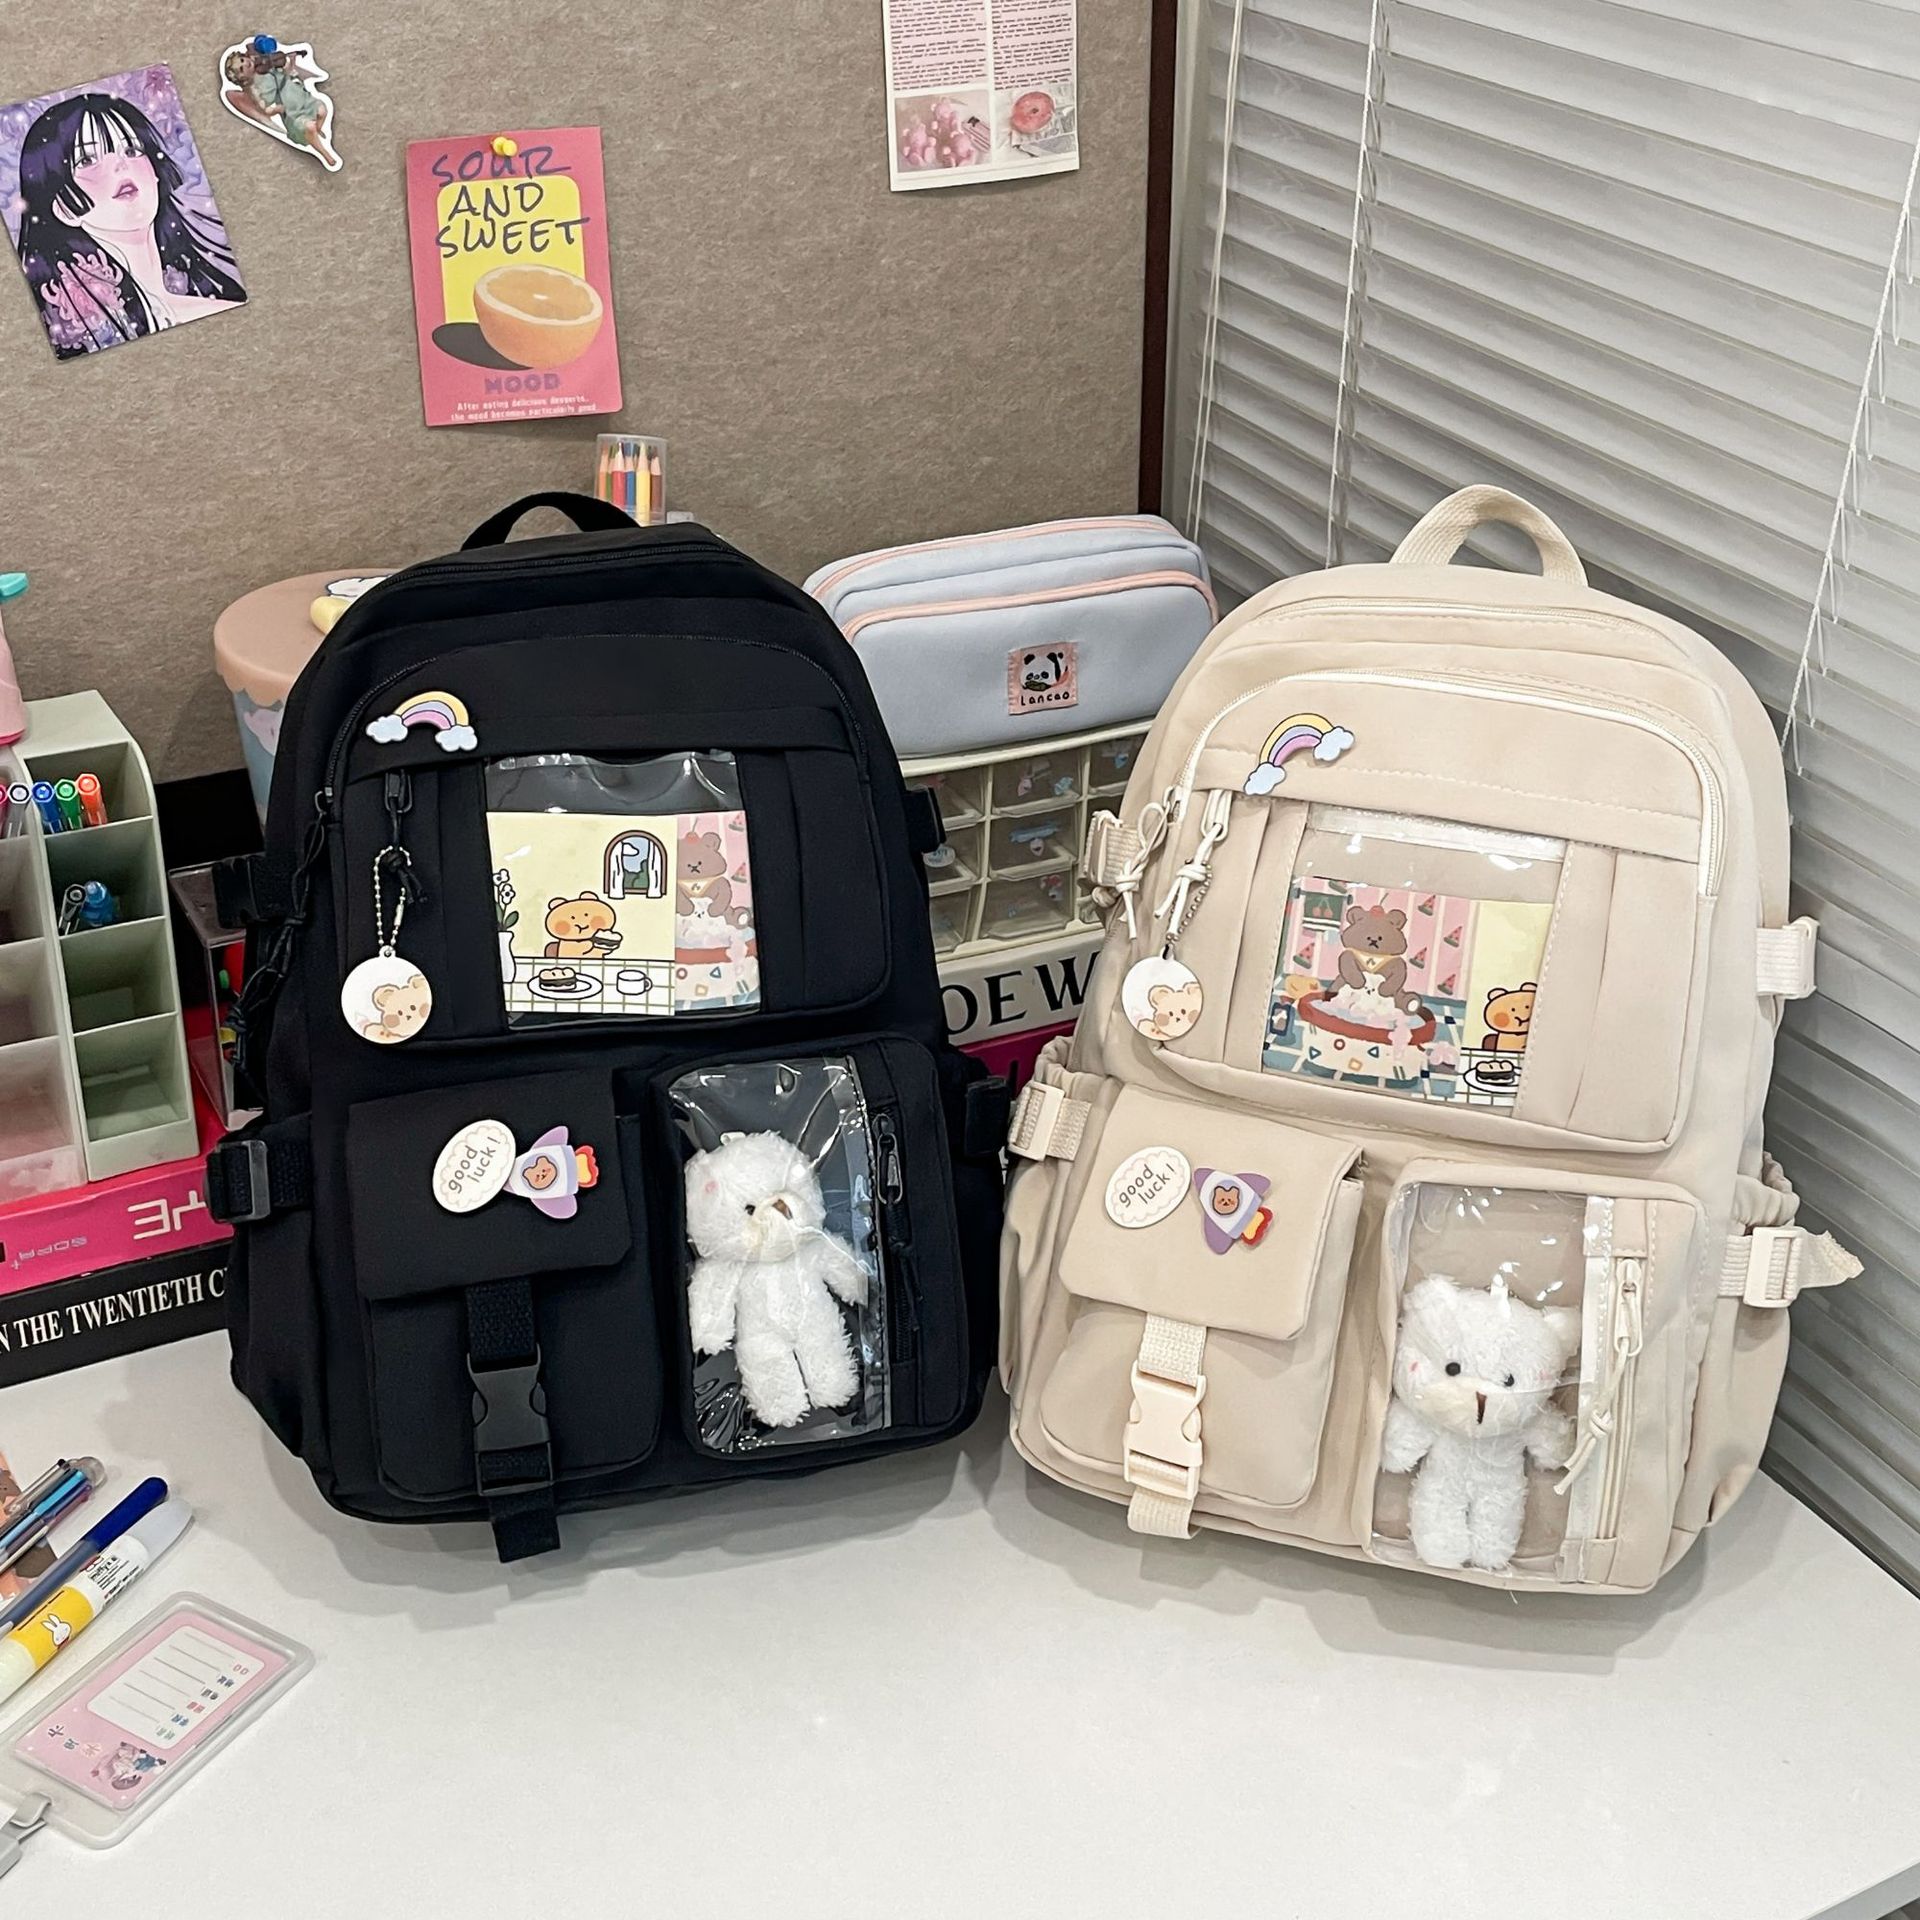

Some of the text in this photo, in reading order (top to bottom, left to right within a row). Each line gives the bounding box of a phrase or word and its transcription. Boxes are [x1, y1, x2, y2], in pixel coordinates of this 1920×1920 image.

[432, 146, 571, 187] SOUR
[448, 182, 544, 222] AND
[436, 217, 590, 258] SWEET
[484, 373, 560, 394] MOOD
[451, 413, 465, 421] the
[467, 411, 488, 420] mood
[457, 402, 479, 411] After
[483, 400, 509, 410] eating
[511, 398, 547, 408] delicious
[448, 1145, 478, 1194] good
[1119, 1163, 1154, 1208] good
[13, 1310, 64, 1349] THE
[66, 1273, 204, 1336] TWENTIETH
[208, 1267, 228, 1298] C
